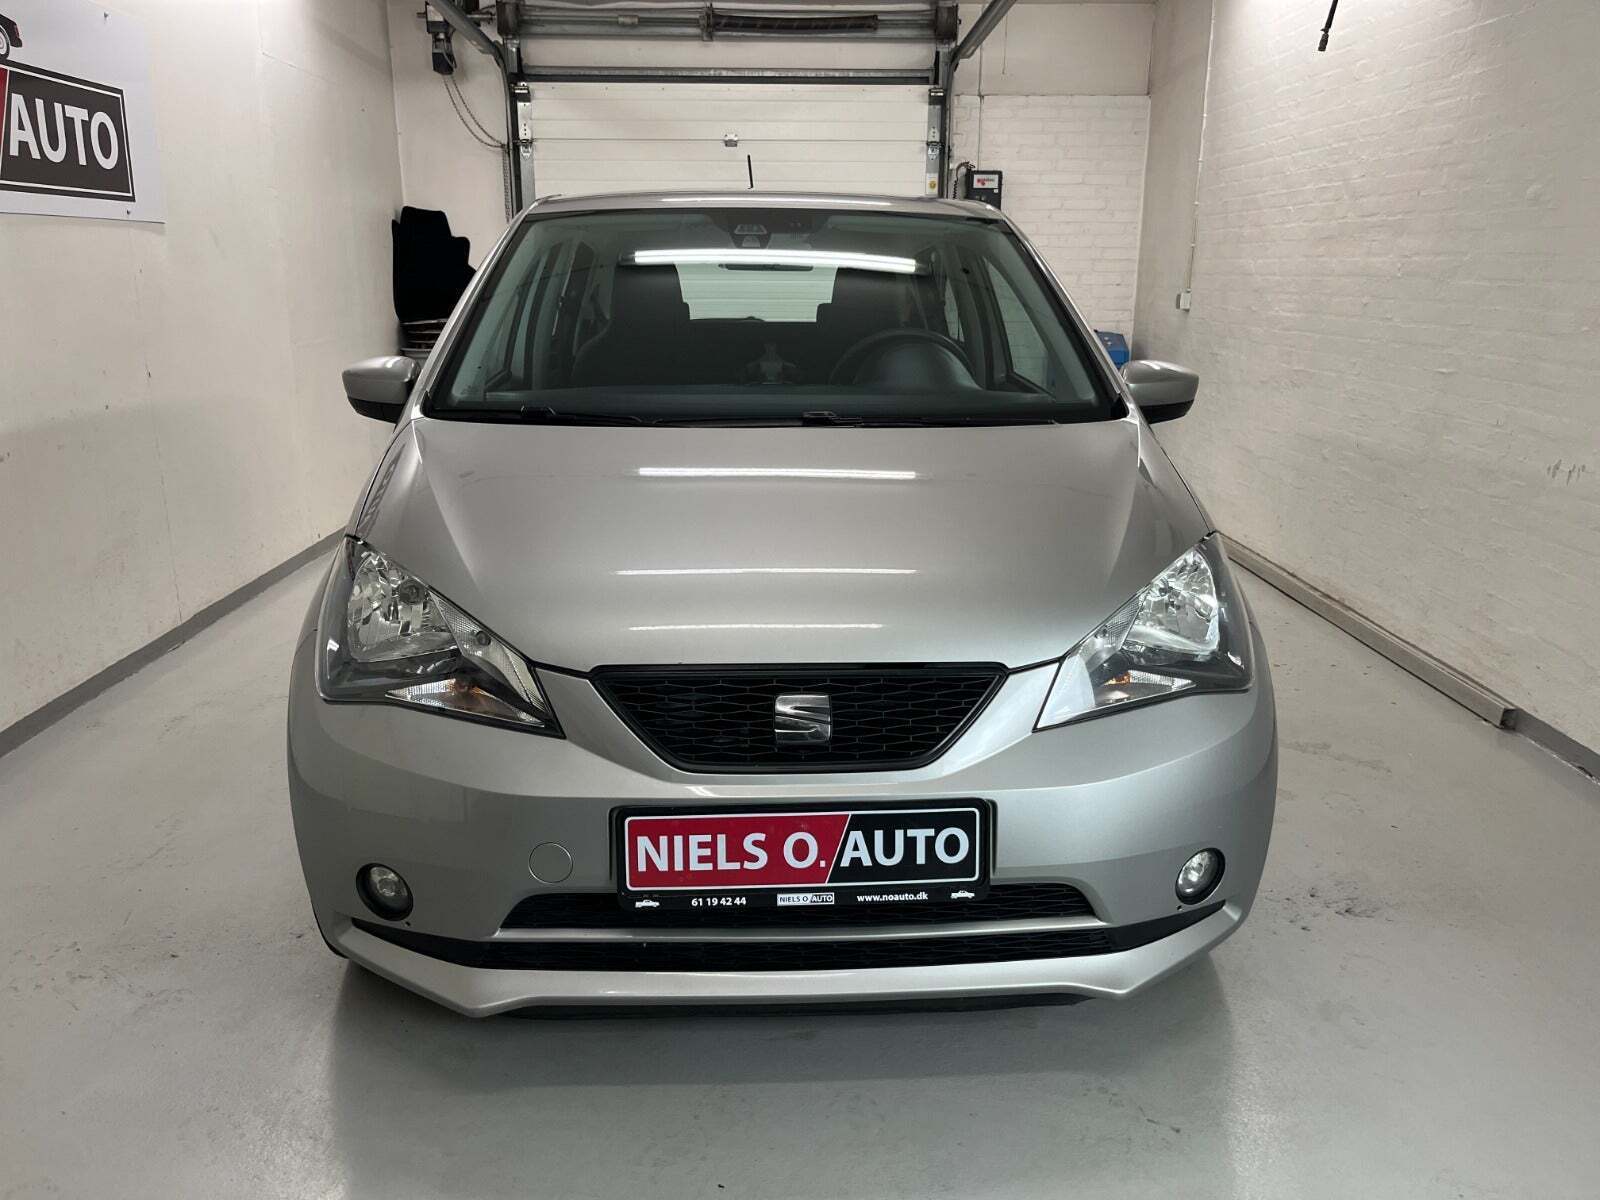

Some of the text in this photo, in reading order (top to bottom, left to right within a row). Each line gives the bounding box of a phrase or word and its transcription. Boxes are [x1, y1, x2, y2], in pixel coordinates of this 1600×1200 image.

[9, 92, 119, 170] AUTO
[636, 827, 970, 872] NIELS O. AUTO
[691, 896, 747, 907] 61 19 42 44
[811, 895, 833, 903] AUTO
[856, 891, 929, 902] www.noauto.dk
